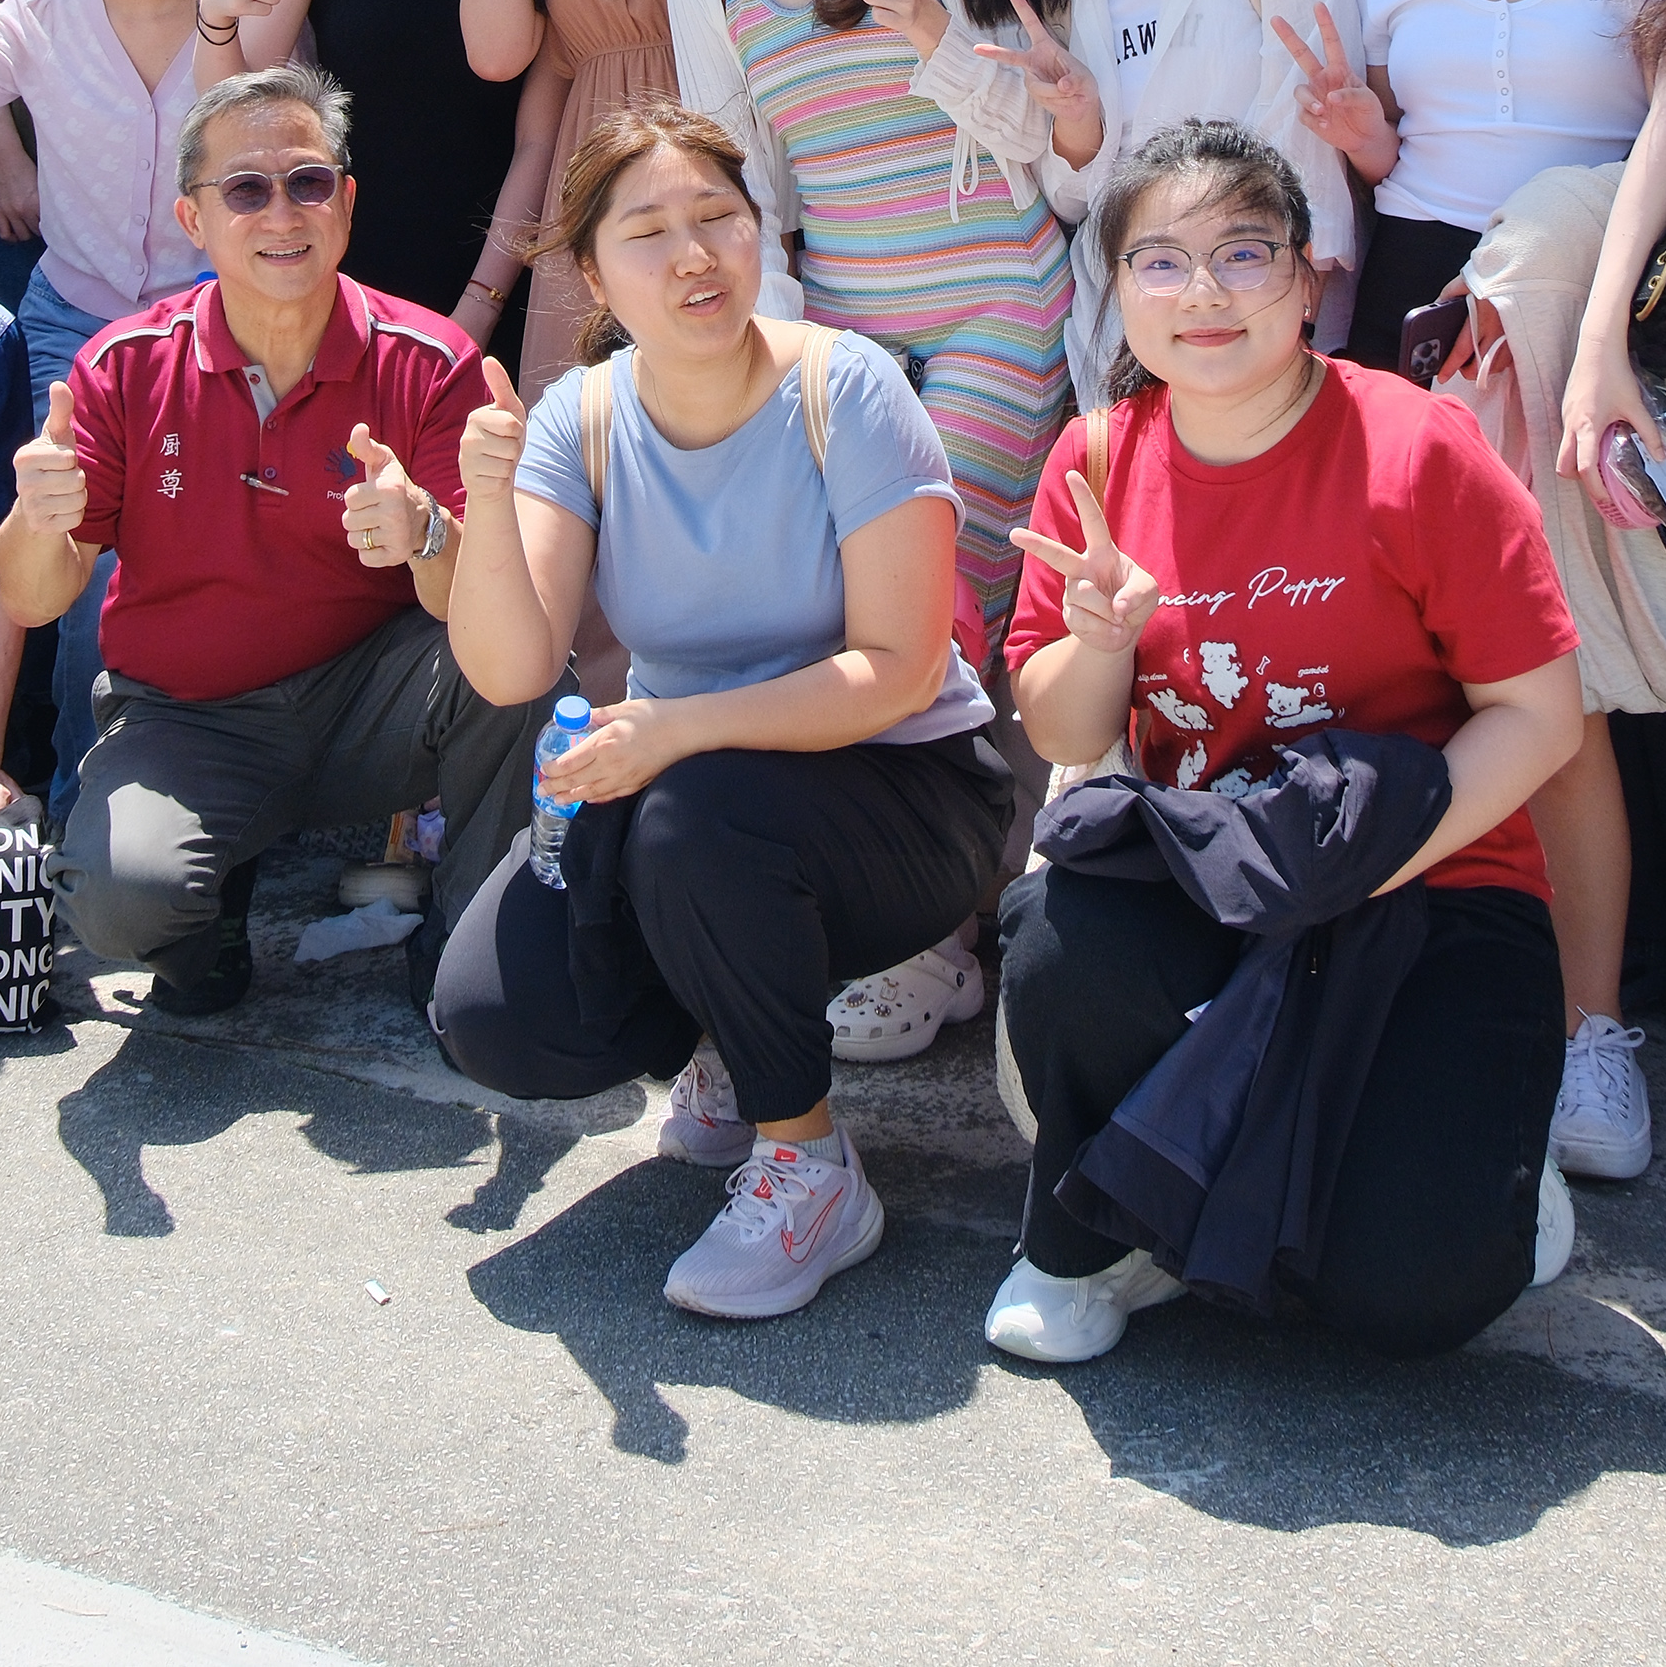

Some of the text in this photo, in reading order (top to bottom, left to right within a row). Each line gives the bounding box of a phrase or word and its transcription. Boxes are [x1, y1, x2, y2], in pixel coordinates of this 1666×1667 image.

[327, 490, 344, 501] Proj
[1158, 566, 1346, 616] ncing Puppy
